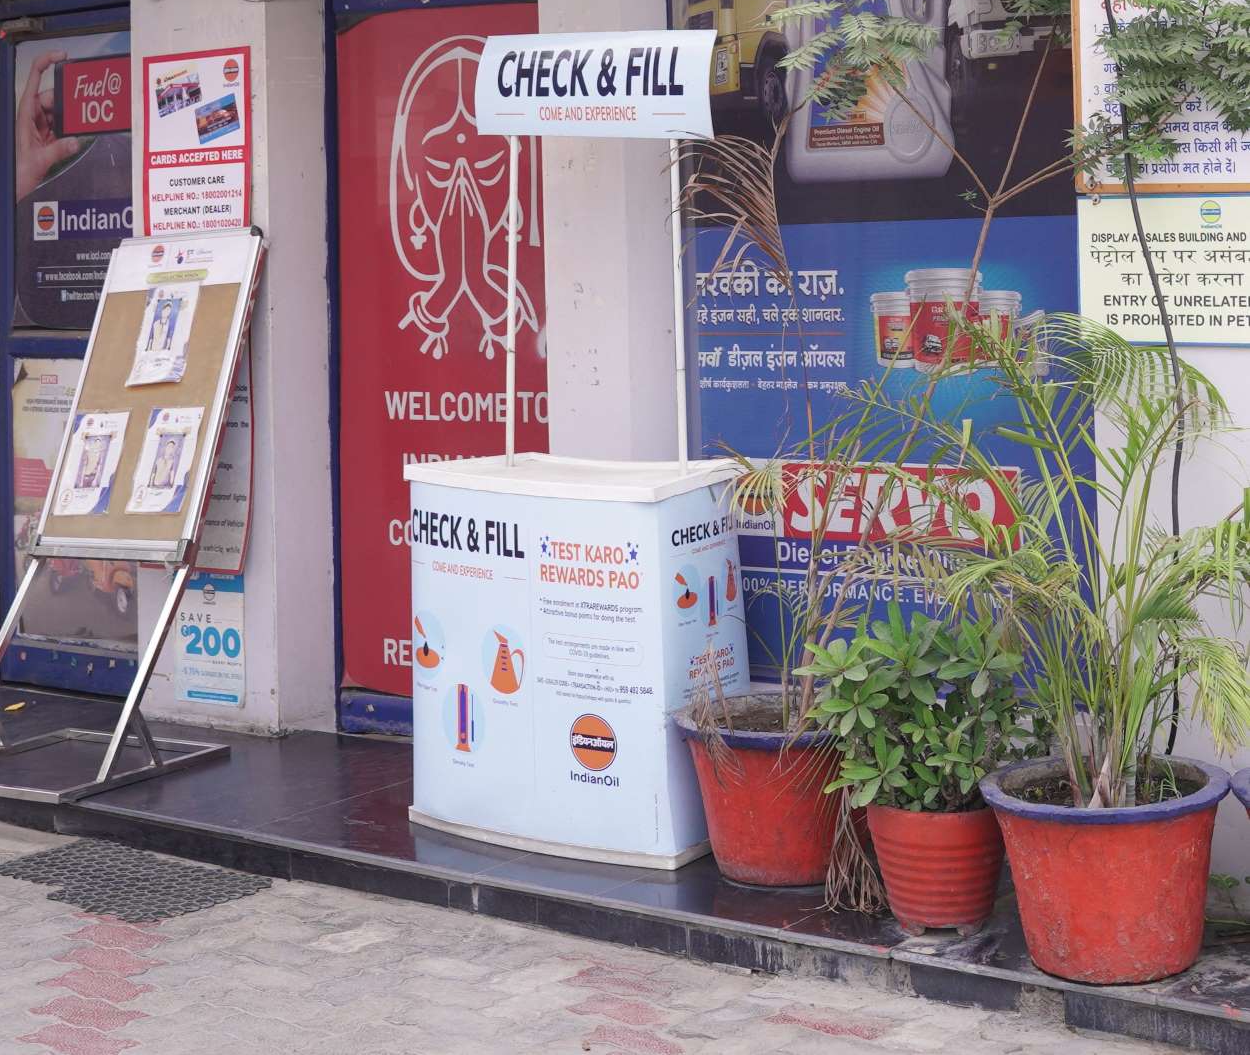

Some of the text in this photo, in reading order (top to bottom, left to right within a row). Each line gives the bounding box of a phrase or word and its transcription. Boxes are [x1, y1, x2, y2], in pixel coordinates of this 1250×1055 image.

[497, 46, 684, 98] CHECK & FILL
[74, 66, 122, 101] Fuel@
[81, 100, 115, 124] IOC
[539, 106, 637, 121] COME AND EXPERIENCE
[151, 148, 244, 165] CARDS ACCEPTED HERE
[169, 175, 226, 187] CUSTOMER CARE
[151, 192, 185, 203] HELPLINE
[164, 204, 232, 216] MERCHANT (DEALER)
[153, 221, 185, 231] HELPLINE
[1091, 232, 1247, 243] DISPLAY SALES BUILDING AND
[1090, 245, 1197, 268] पेट्रोल पर
[1121, 273, 1245, 286] का करना
[1103, 295, 1147, 307] ENTRY
[1107, 314, 1119, 325] IS
[1210, 315, 1222, 326] IN
[384, 390, 550, 424] WELCOME TO
[790, 471, 996, 540] SERVO
[412, 508, 462, 551] CHECK
[467, 518, 480, 553] &
[485, 520, 525, 559] FILL
[671, 520, 720, 546] CHECK &
[550, 541, 624, 565] TEST KARO
[540, 564, 640, 590] REWARDS PAO
[180, 612, 211, 624] SAVE
[570, 770, 620, 787] IndianOil
